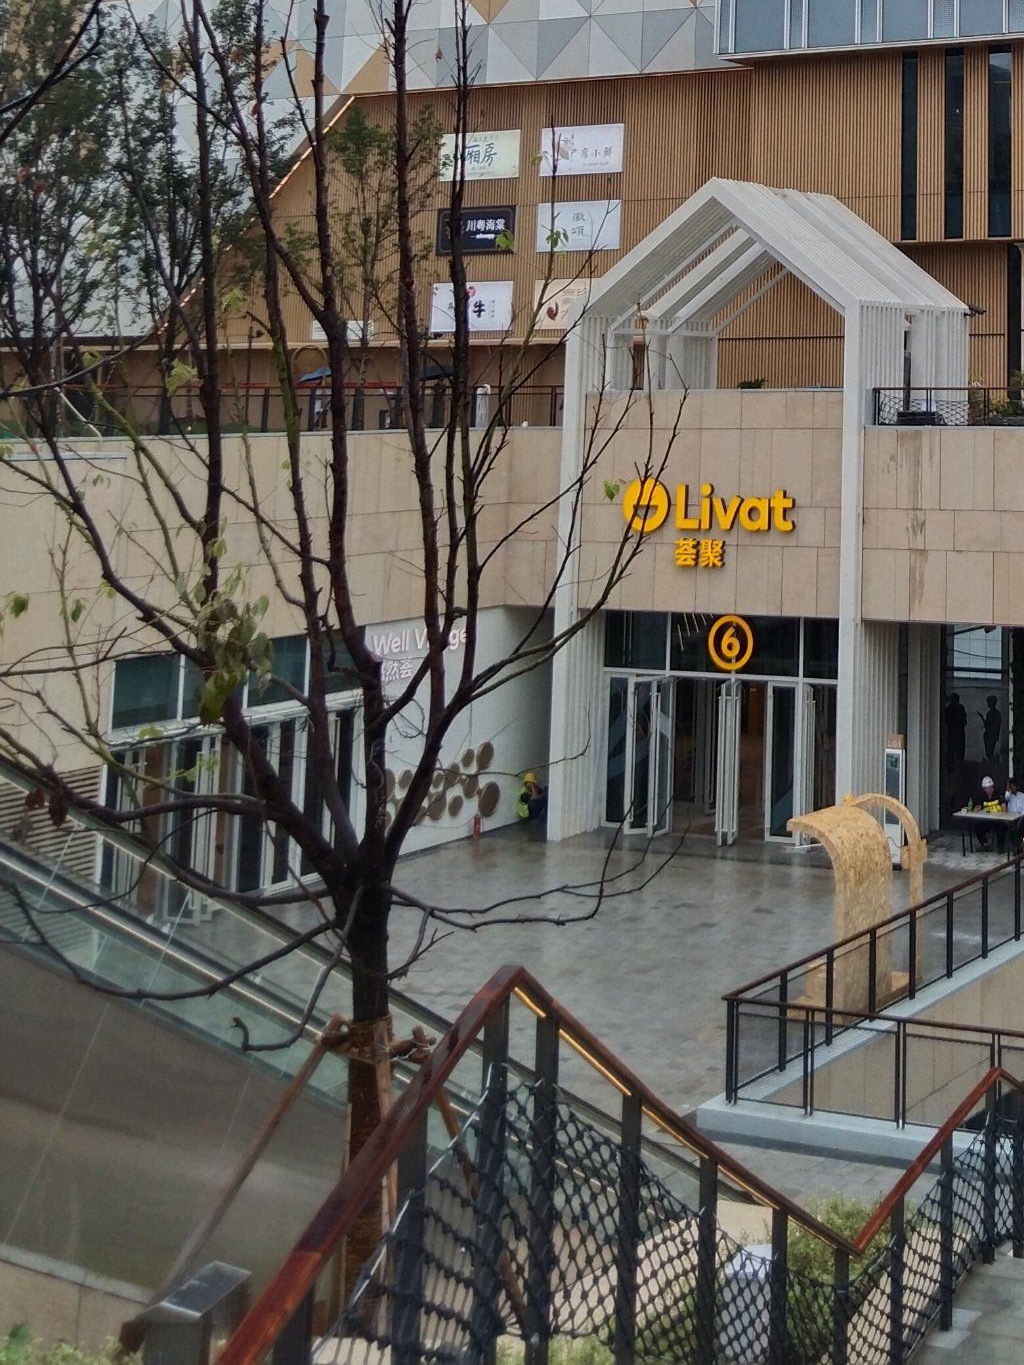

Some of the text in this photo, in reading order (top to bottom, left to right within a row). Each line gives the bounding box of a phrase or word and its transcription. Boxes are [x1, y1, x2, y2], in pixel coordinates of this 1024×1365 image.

[675, 482, 796, 532] Livat
[674, 537, 726, 568] 荟聚
[373, 629, 410, 656] Well
